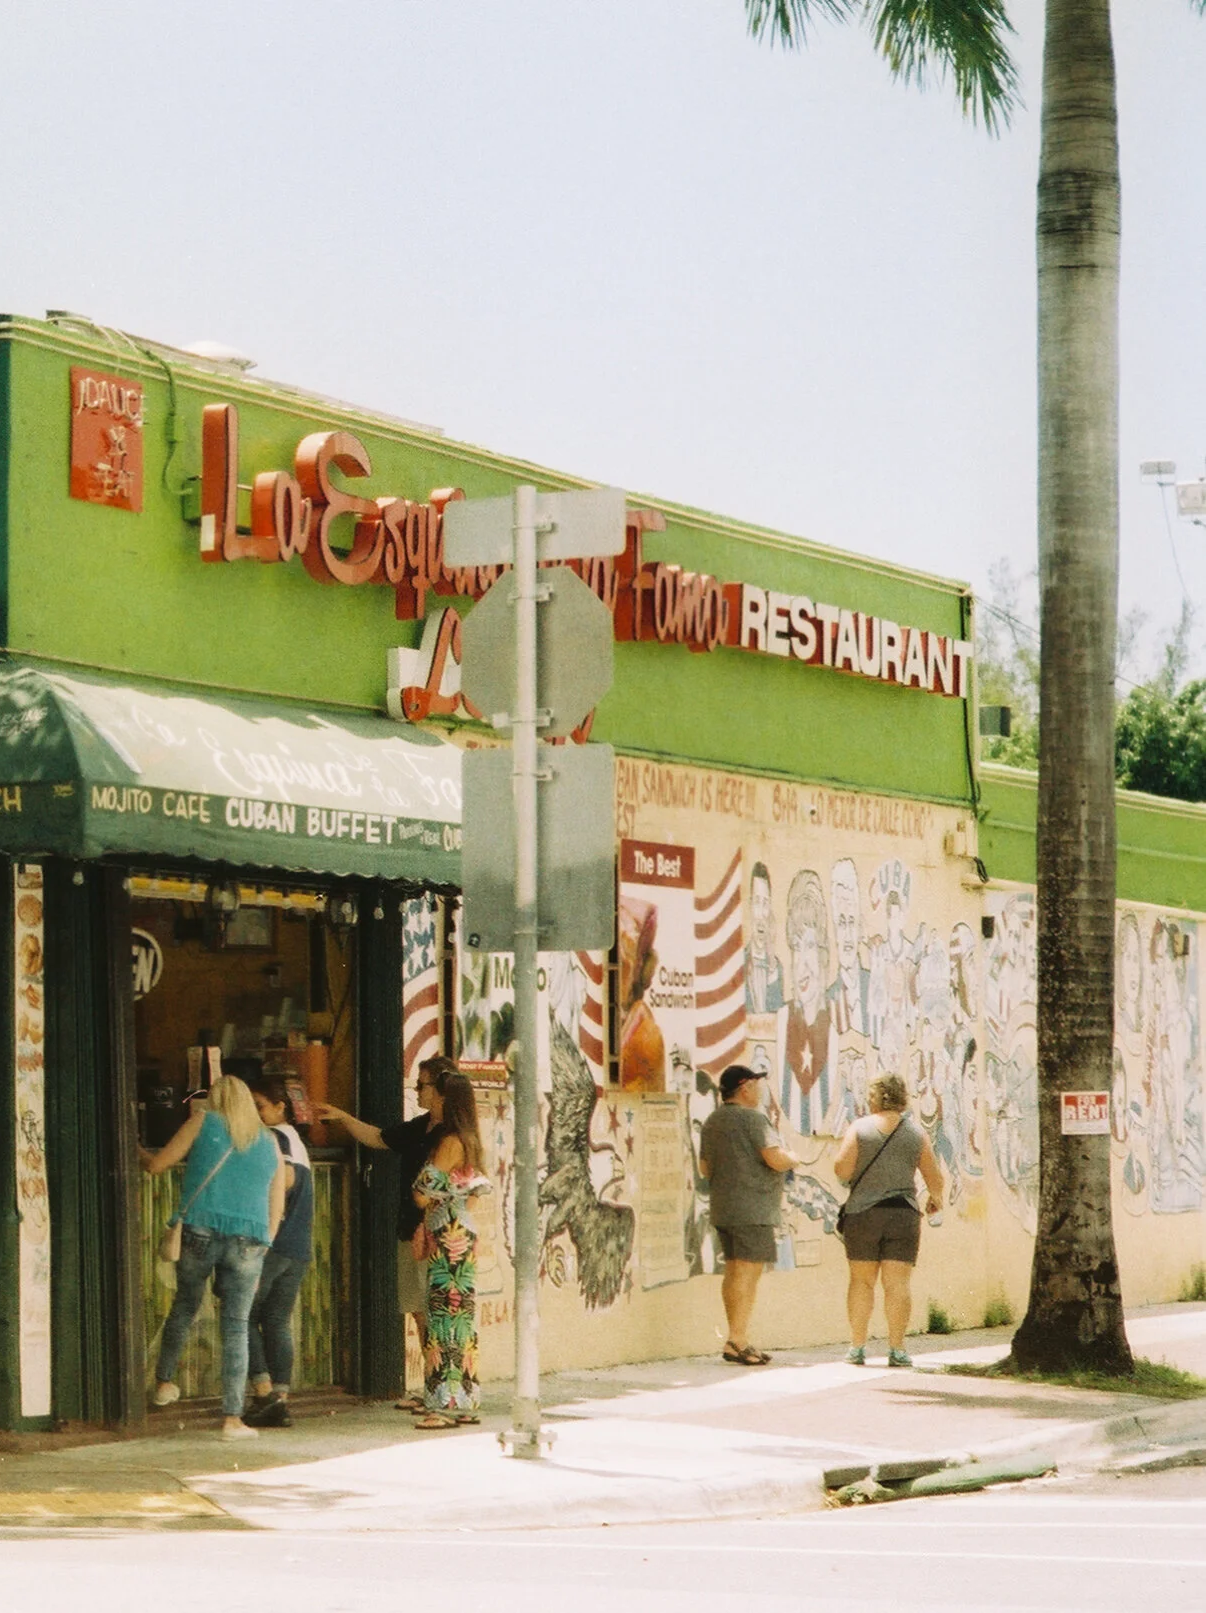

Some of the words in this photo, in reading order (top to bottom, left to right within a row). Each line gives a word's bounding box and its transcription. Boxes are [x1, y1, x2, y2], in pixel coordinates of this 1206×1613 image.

[200, 402, 312, 563] La
[296, 431, 506, 620] Esqu
[740, 583, 974, 699] RESTAURANT
[616, 759, 639, 800] BAN
[642, 763, 697, 809] SANDWICH
[700, 774, 713, 813] IS
[92, 785, 153, 814] MOJITO
[225, 798, 296, 835] CUBAN
[307, 808, 398, 845] BUFFET
[616, 800, 636, 838] EST
[634, 850, 654, 875] The
[657, 852, 681, 877] Best
[659, 966, 694, 987] Cuban
[649, 988, 694, 1009] Sandwich
[1063, 1105, 1108, 1120] RENT
